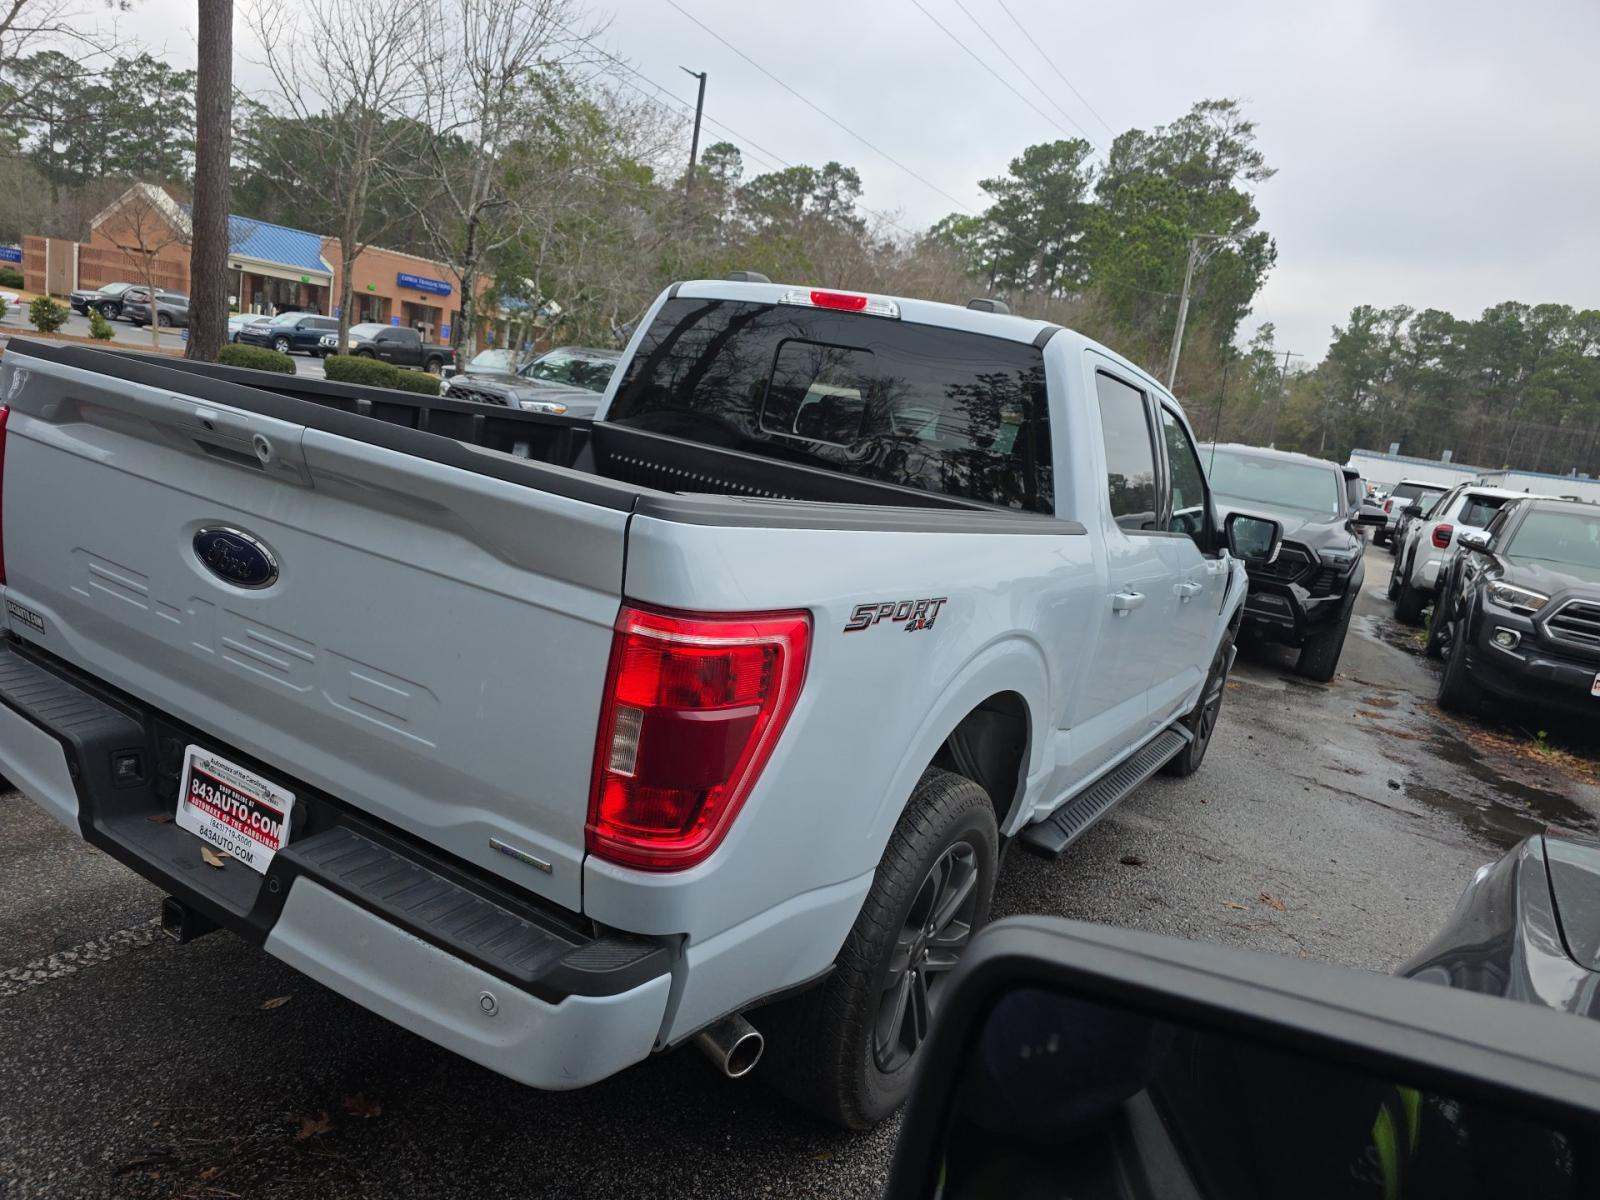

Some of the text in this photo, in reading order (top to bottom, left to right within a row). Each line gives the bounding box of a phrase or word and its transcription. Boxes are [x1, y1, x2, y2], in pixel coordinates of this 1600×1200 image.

[207, 537, 254, 578] Ford
[843, 597, 948, 633] SPORT
[71, 546, 440, 748] F-150
[191, 778, 282, 839] 843AUTO.COM
[243, 826, 279, 851] CAROLINAS
